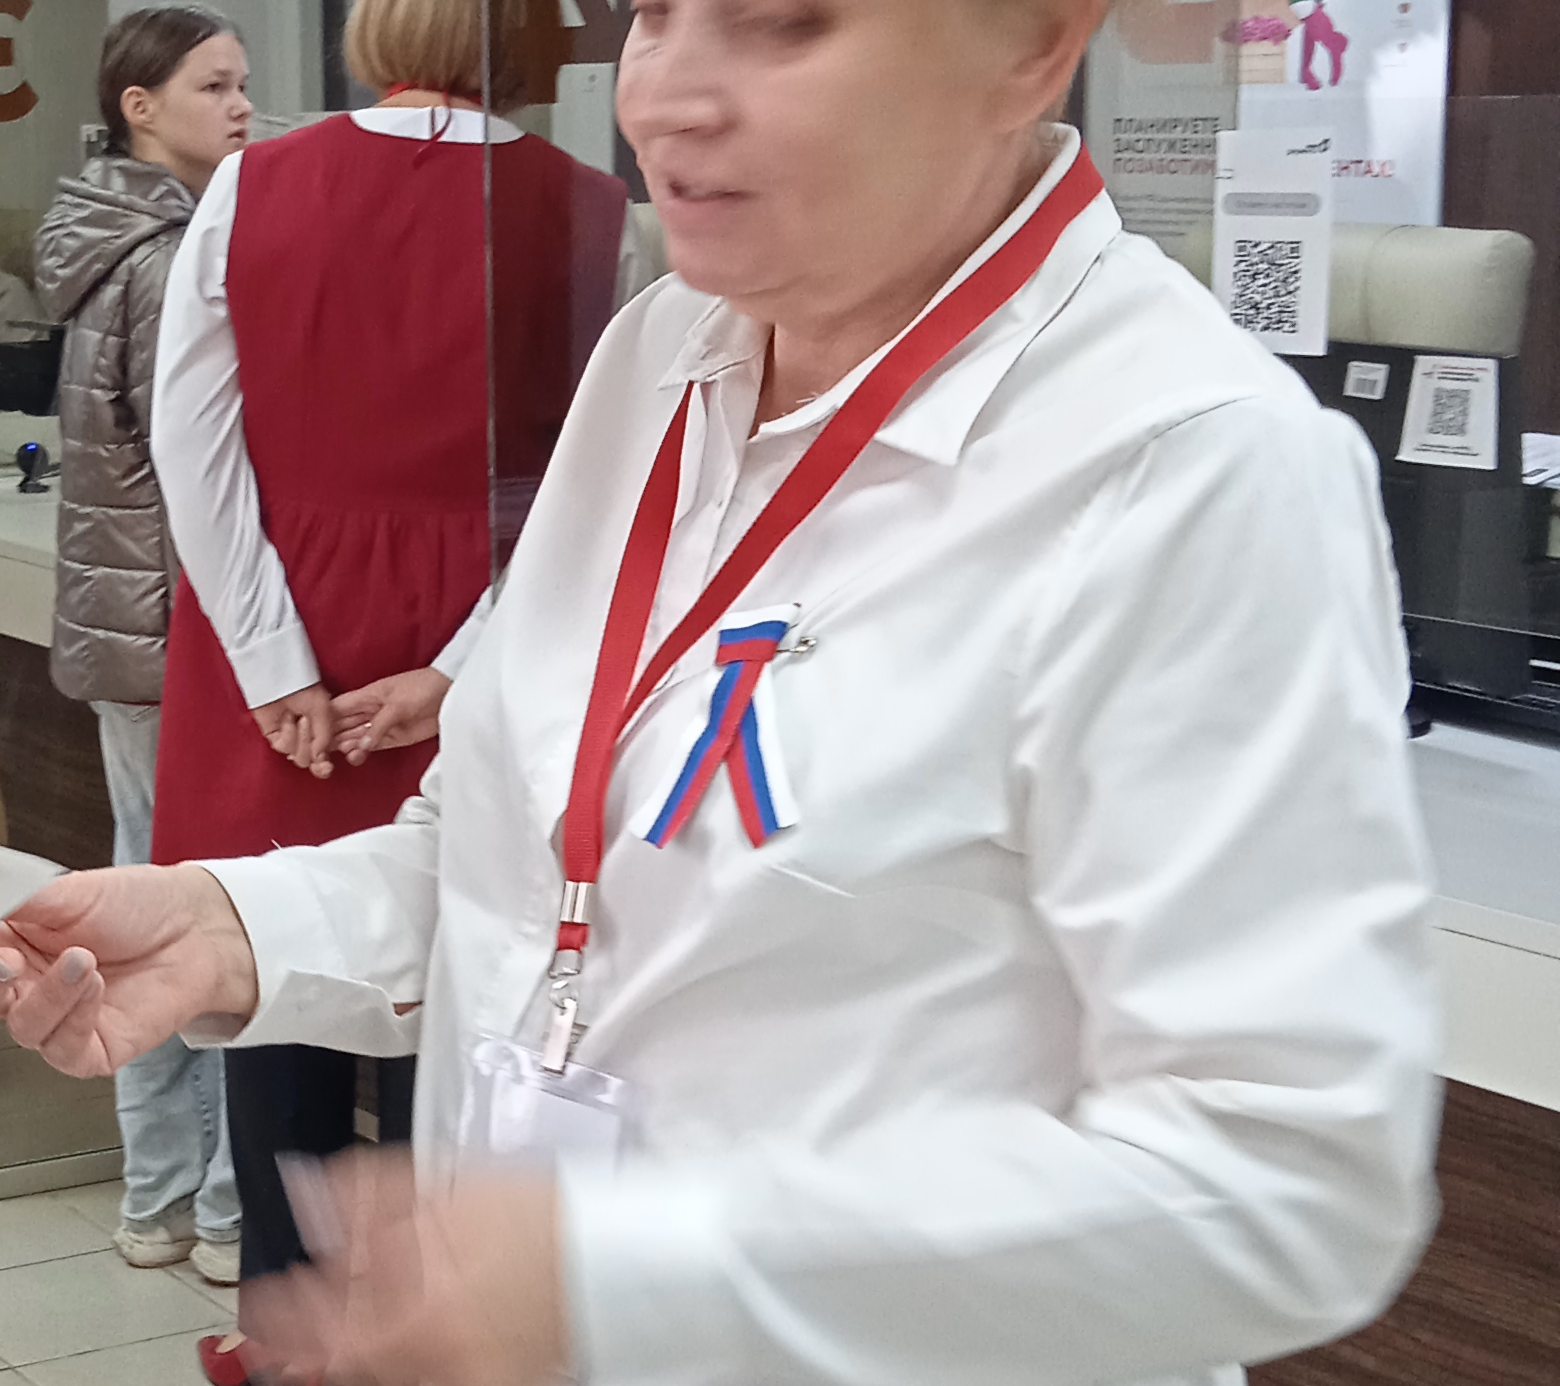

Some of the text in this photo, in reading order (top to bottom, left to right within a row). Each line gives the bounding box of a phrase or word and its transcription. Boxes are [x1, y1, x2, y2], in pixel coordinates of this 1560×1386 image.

[1113, 117, 1219, 134] ПЛАНИРУЕТЕ
[1113, 138, 1216, 154] ЗАСЛУЖЕНН
[1113, 158, 1216, 174] ПОЗАБОТИМ
